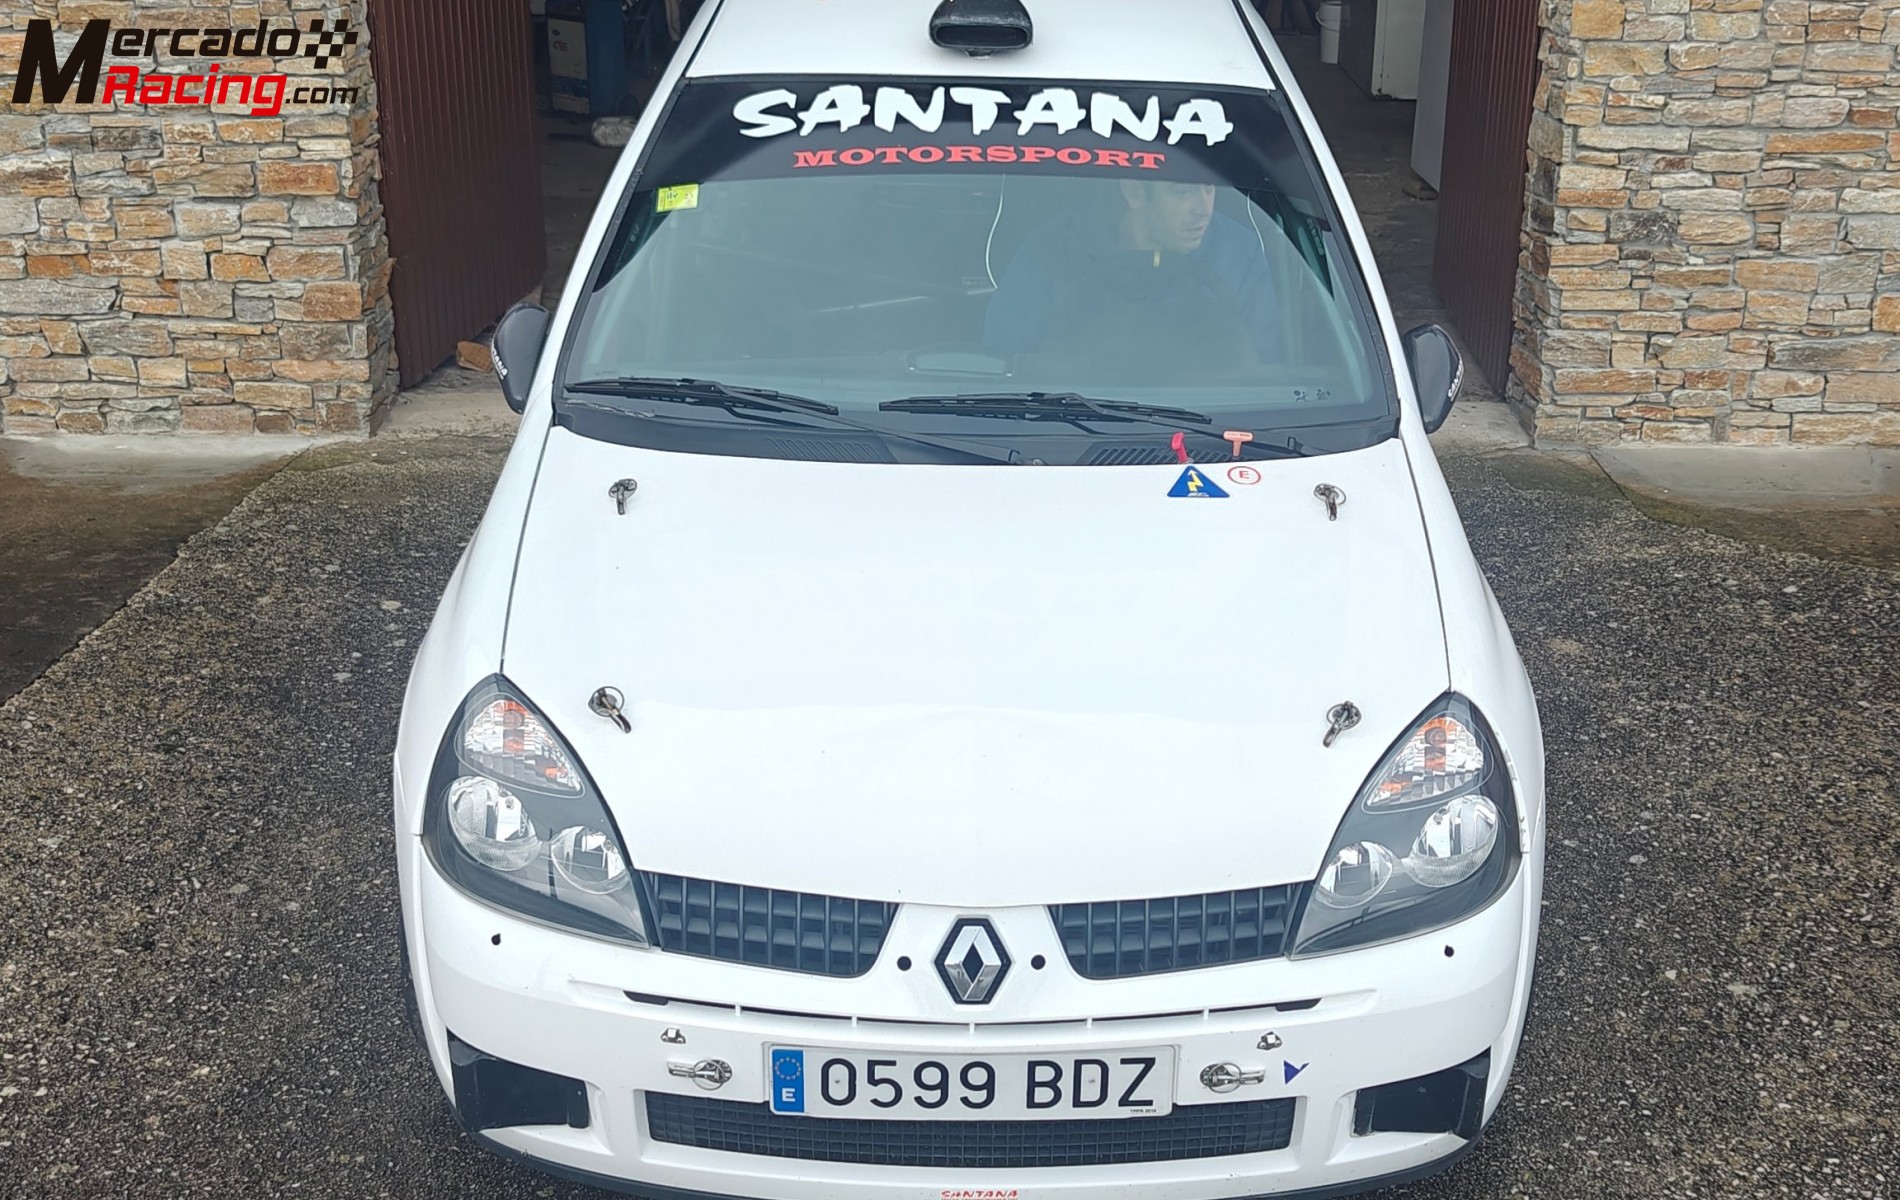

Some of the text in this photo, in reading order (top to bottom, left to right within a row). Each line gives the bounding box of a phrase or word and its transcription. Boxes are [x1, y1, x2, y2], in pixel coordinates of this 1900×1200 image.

[733, 84, 1234, 146] SANTANA
[793, 144, 1165, 169] MOTORSPORT
[1239, 470, 1250, 480] E
[820, 1057, 1156, 1110] 0599 BDZ
[781, 1088, 796, 1102] E
[941, 1189, 1018, 1198] SANTANA
